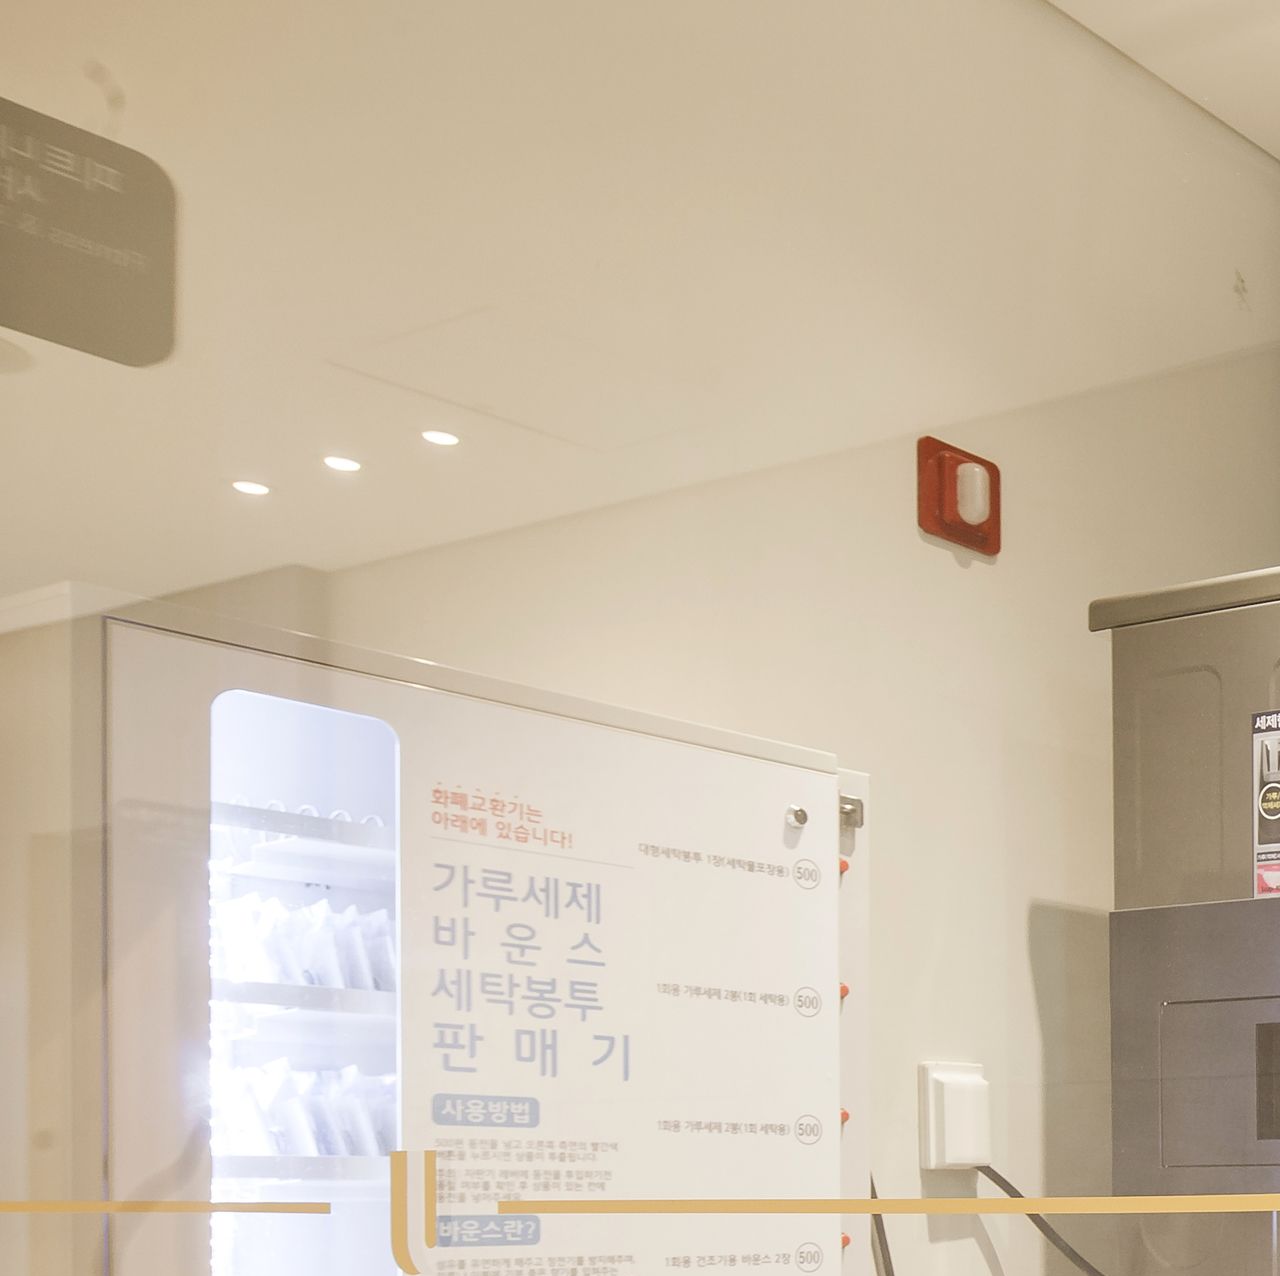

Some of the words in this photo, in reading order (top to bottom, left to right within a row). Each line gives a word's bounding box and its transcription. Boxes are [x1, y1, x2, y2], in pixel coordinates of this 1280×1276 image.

[431, 787, 543, 825] 화폐교환기는
[431, 811, 487, 837] 아래에
[496, 820, 574, 849] 있습니다!
[797, 865, 818, 882] 500
[431, 862, 603, 925] 가루세제
[431, 968, 604, 1022] 세탁봉투
[797, 994, 818, 1010] 500
[441, 1099, 530, 1124] 사용방법
[798, 1122, 819, 1138] 500
[438, 1219, 536, 1243] 바운스란?
[741, 1252, 772, 1267] 바운스
[799, 1249, 820, 1265] 500
